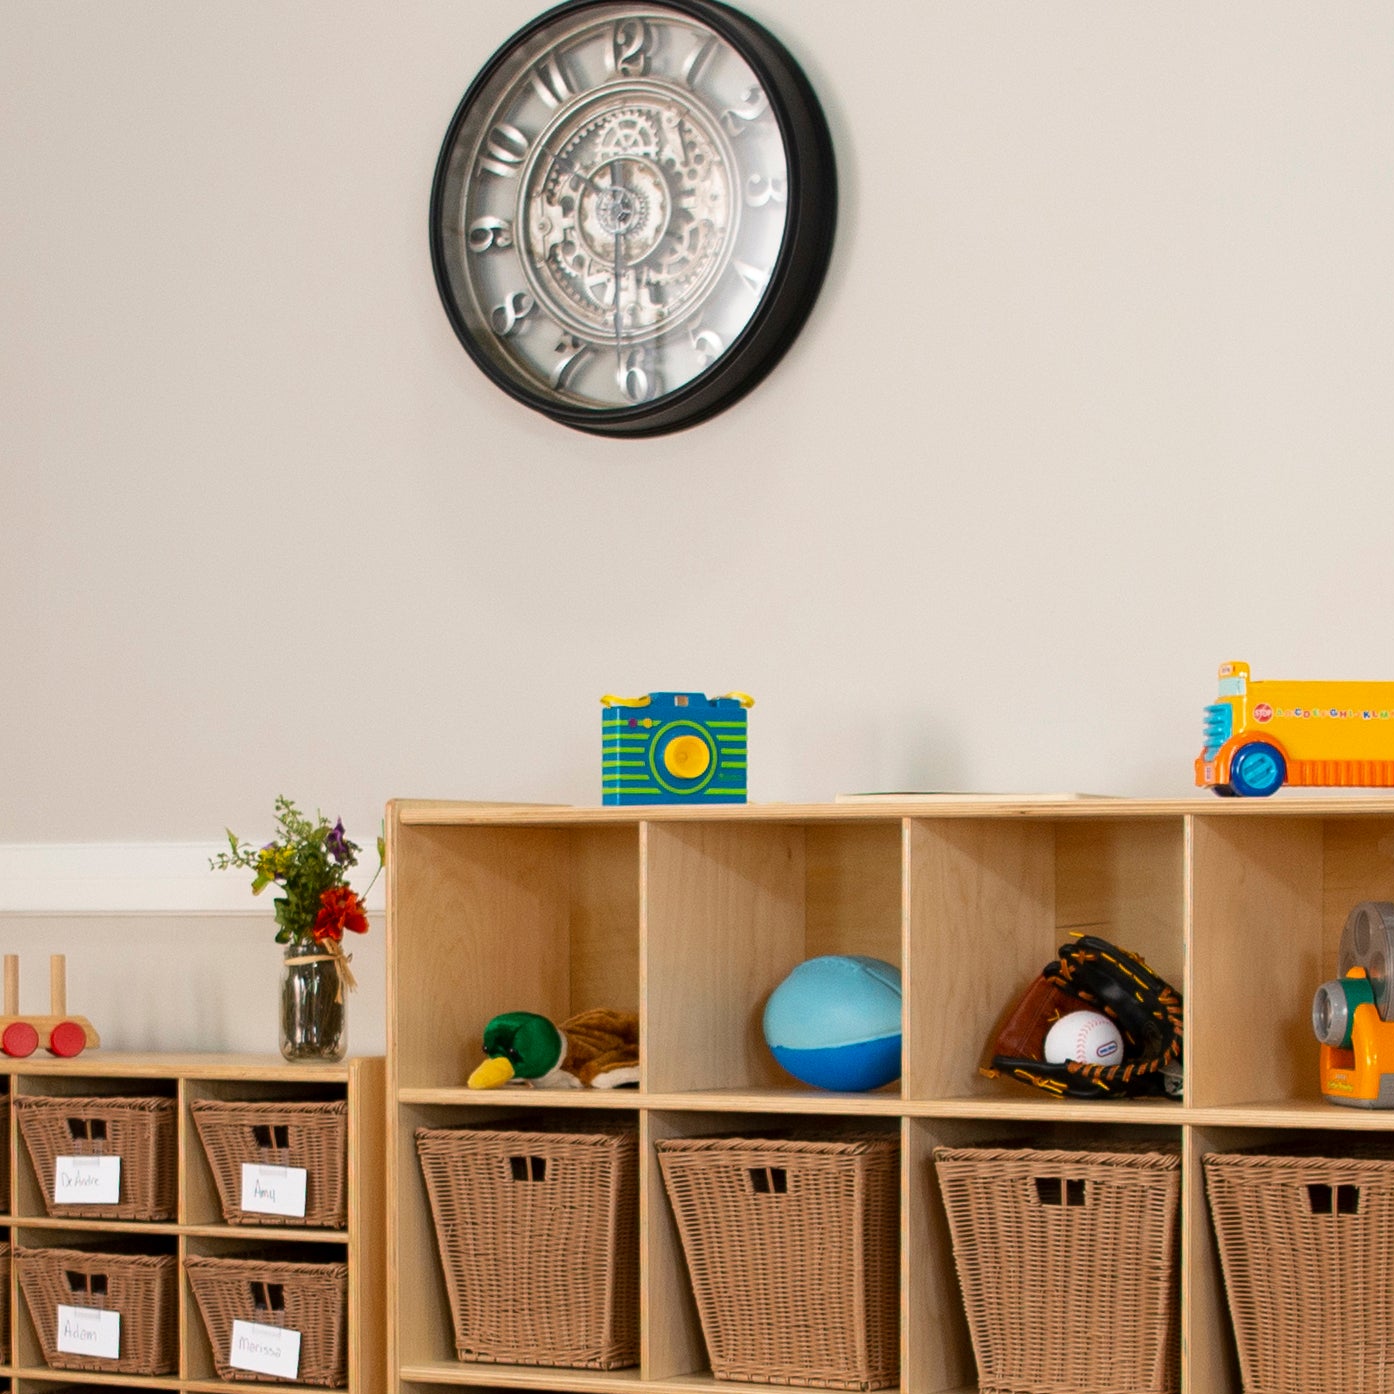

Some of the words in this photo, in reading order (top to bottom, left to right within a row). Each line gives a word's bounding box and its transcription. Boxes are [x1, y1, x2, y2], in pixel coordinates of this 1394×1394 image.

[603, 18, 648, 76] 12
[527, 55, 576, 109] 11
[720, 85, 770, 136] 2
[477, 122, 529, 178] 10
[745, 173, 787, 208] 3
[469, 215, 514, 253] 9
[491, 291, 534, 336] 8
[616, 345, 648, 401] 6
[253, 1179, 277, 1203] Amy
[63, 1320, 98, 1342] Adam
